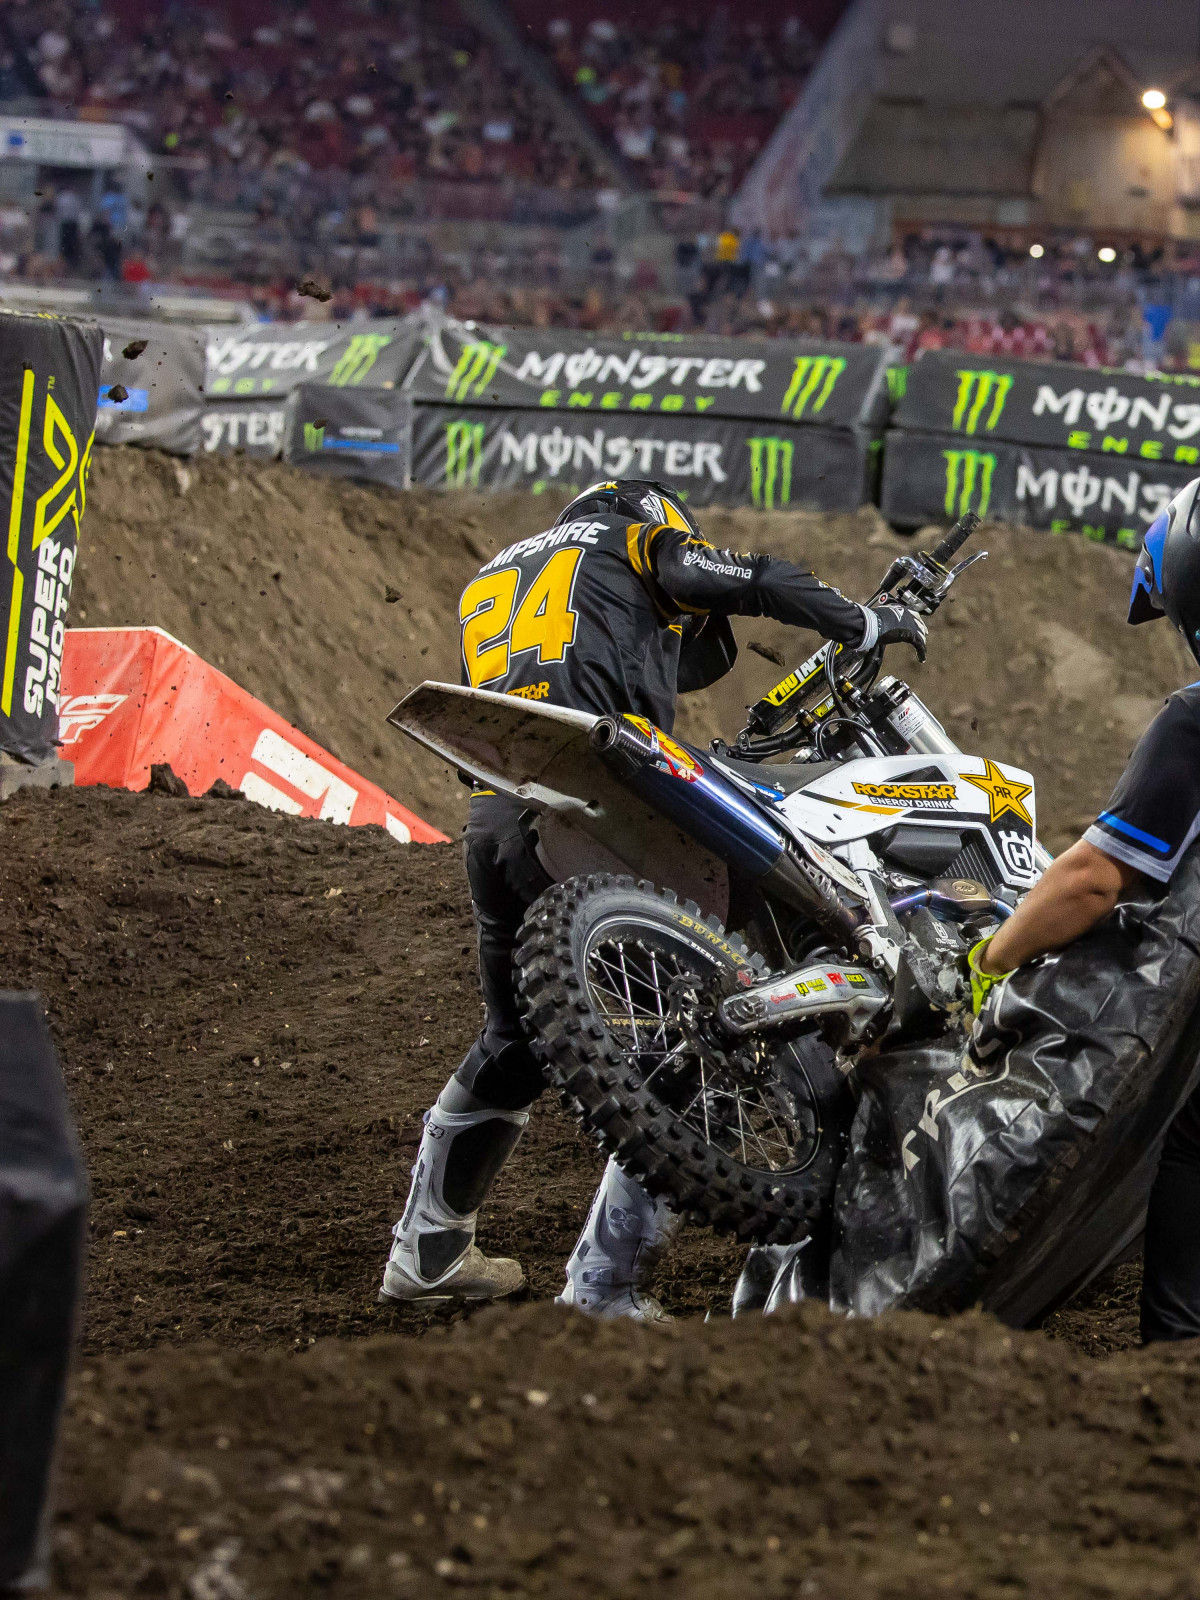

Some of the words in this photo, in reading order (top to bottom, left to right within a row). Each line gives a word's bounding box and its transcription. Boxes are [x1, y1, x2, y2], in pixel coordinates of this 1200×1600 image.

[515, 347, 767, 393] MONSTER
[500, 425, 729, 484] MONSTER
[693, 552, 753, 580] Husqvarna
[23, 536, 62, 719] SUPER
[458, 545, 587, 689] 24
[851, 782, 959, 801] ROCKSTAR
[869, 797, 914, 809] ENERGY
[915, 798, 954, 810] DRINK
